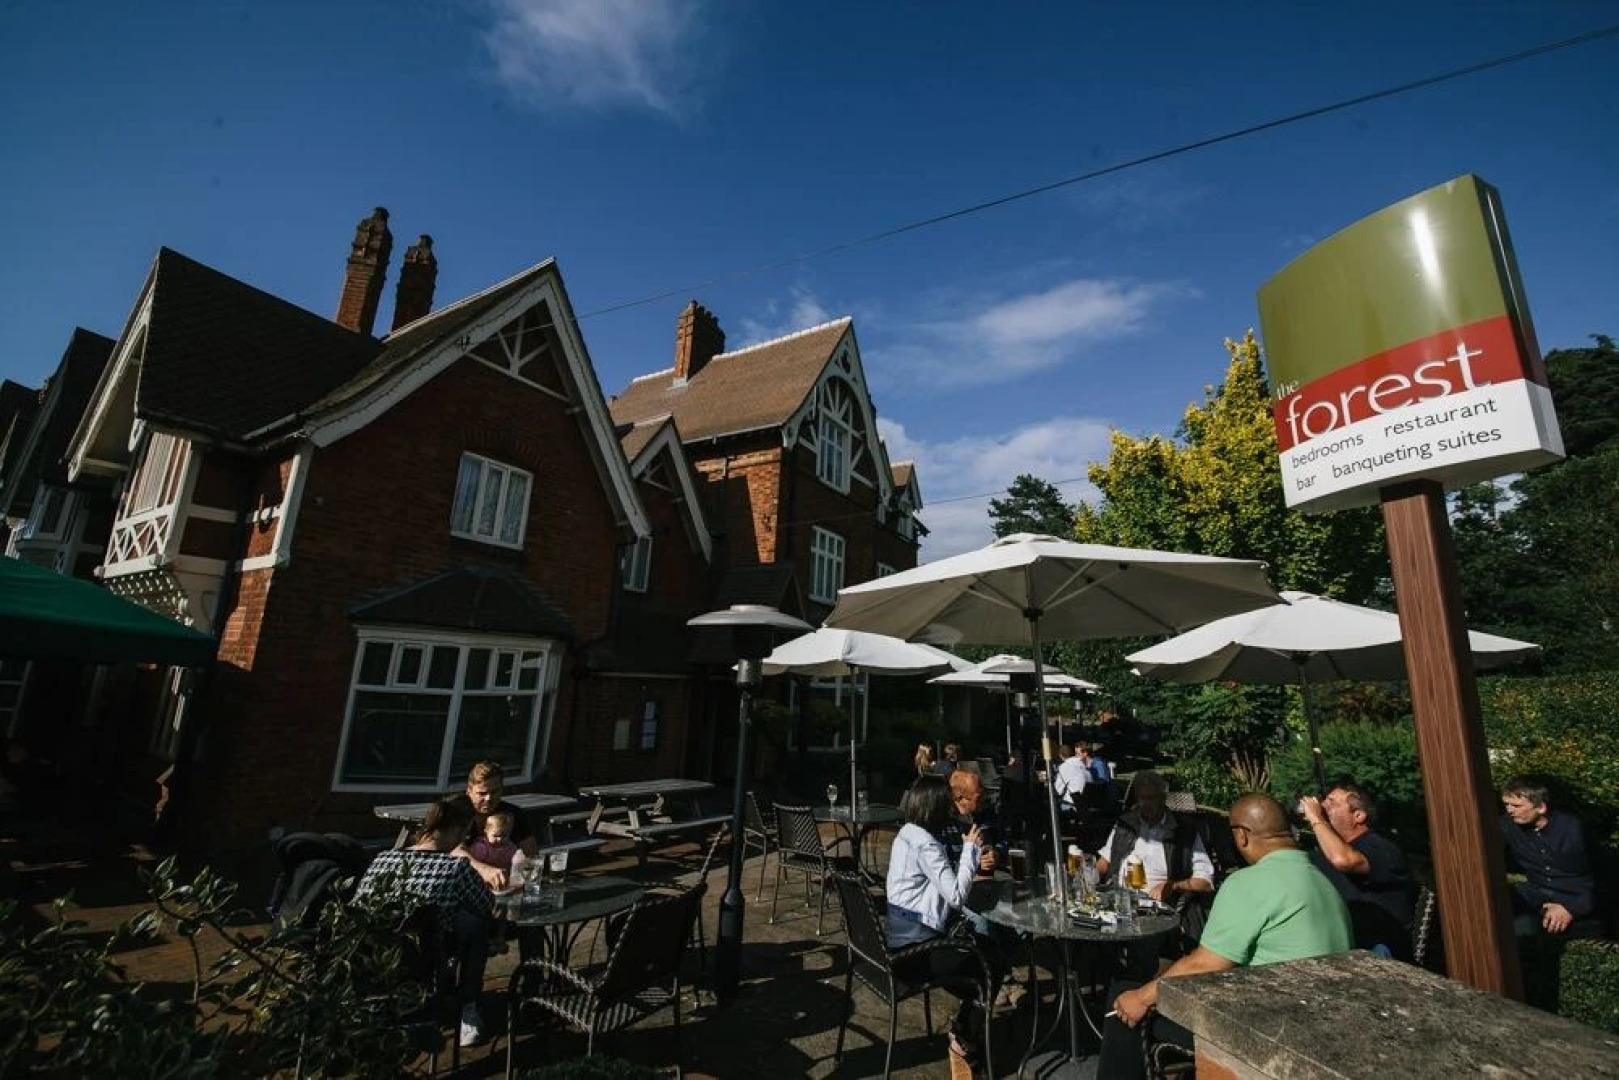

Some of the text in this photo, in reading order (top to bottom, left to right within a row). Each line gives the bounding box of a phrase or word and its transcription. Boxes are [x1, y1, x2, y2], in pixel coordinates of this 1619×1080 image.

[1276, 379, 1299, 400] the
[1286, 340, 1491, 446] forest
[1291, 399, 1498, 468] bedrooms restaurant
[1296, 428, 1502, 491] bar banqueting suites
